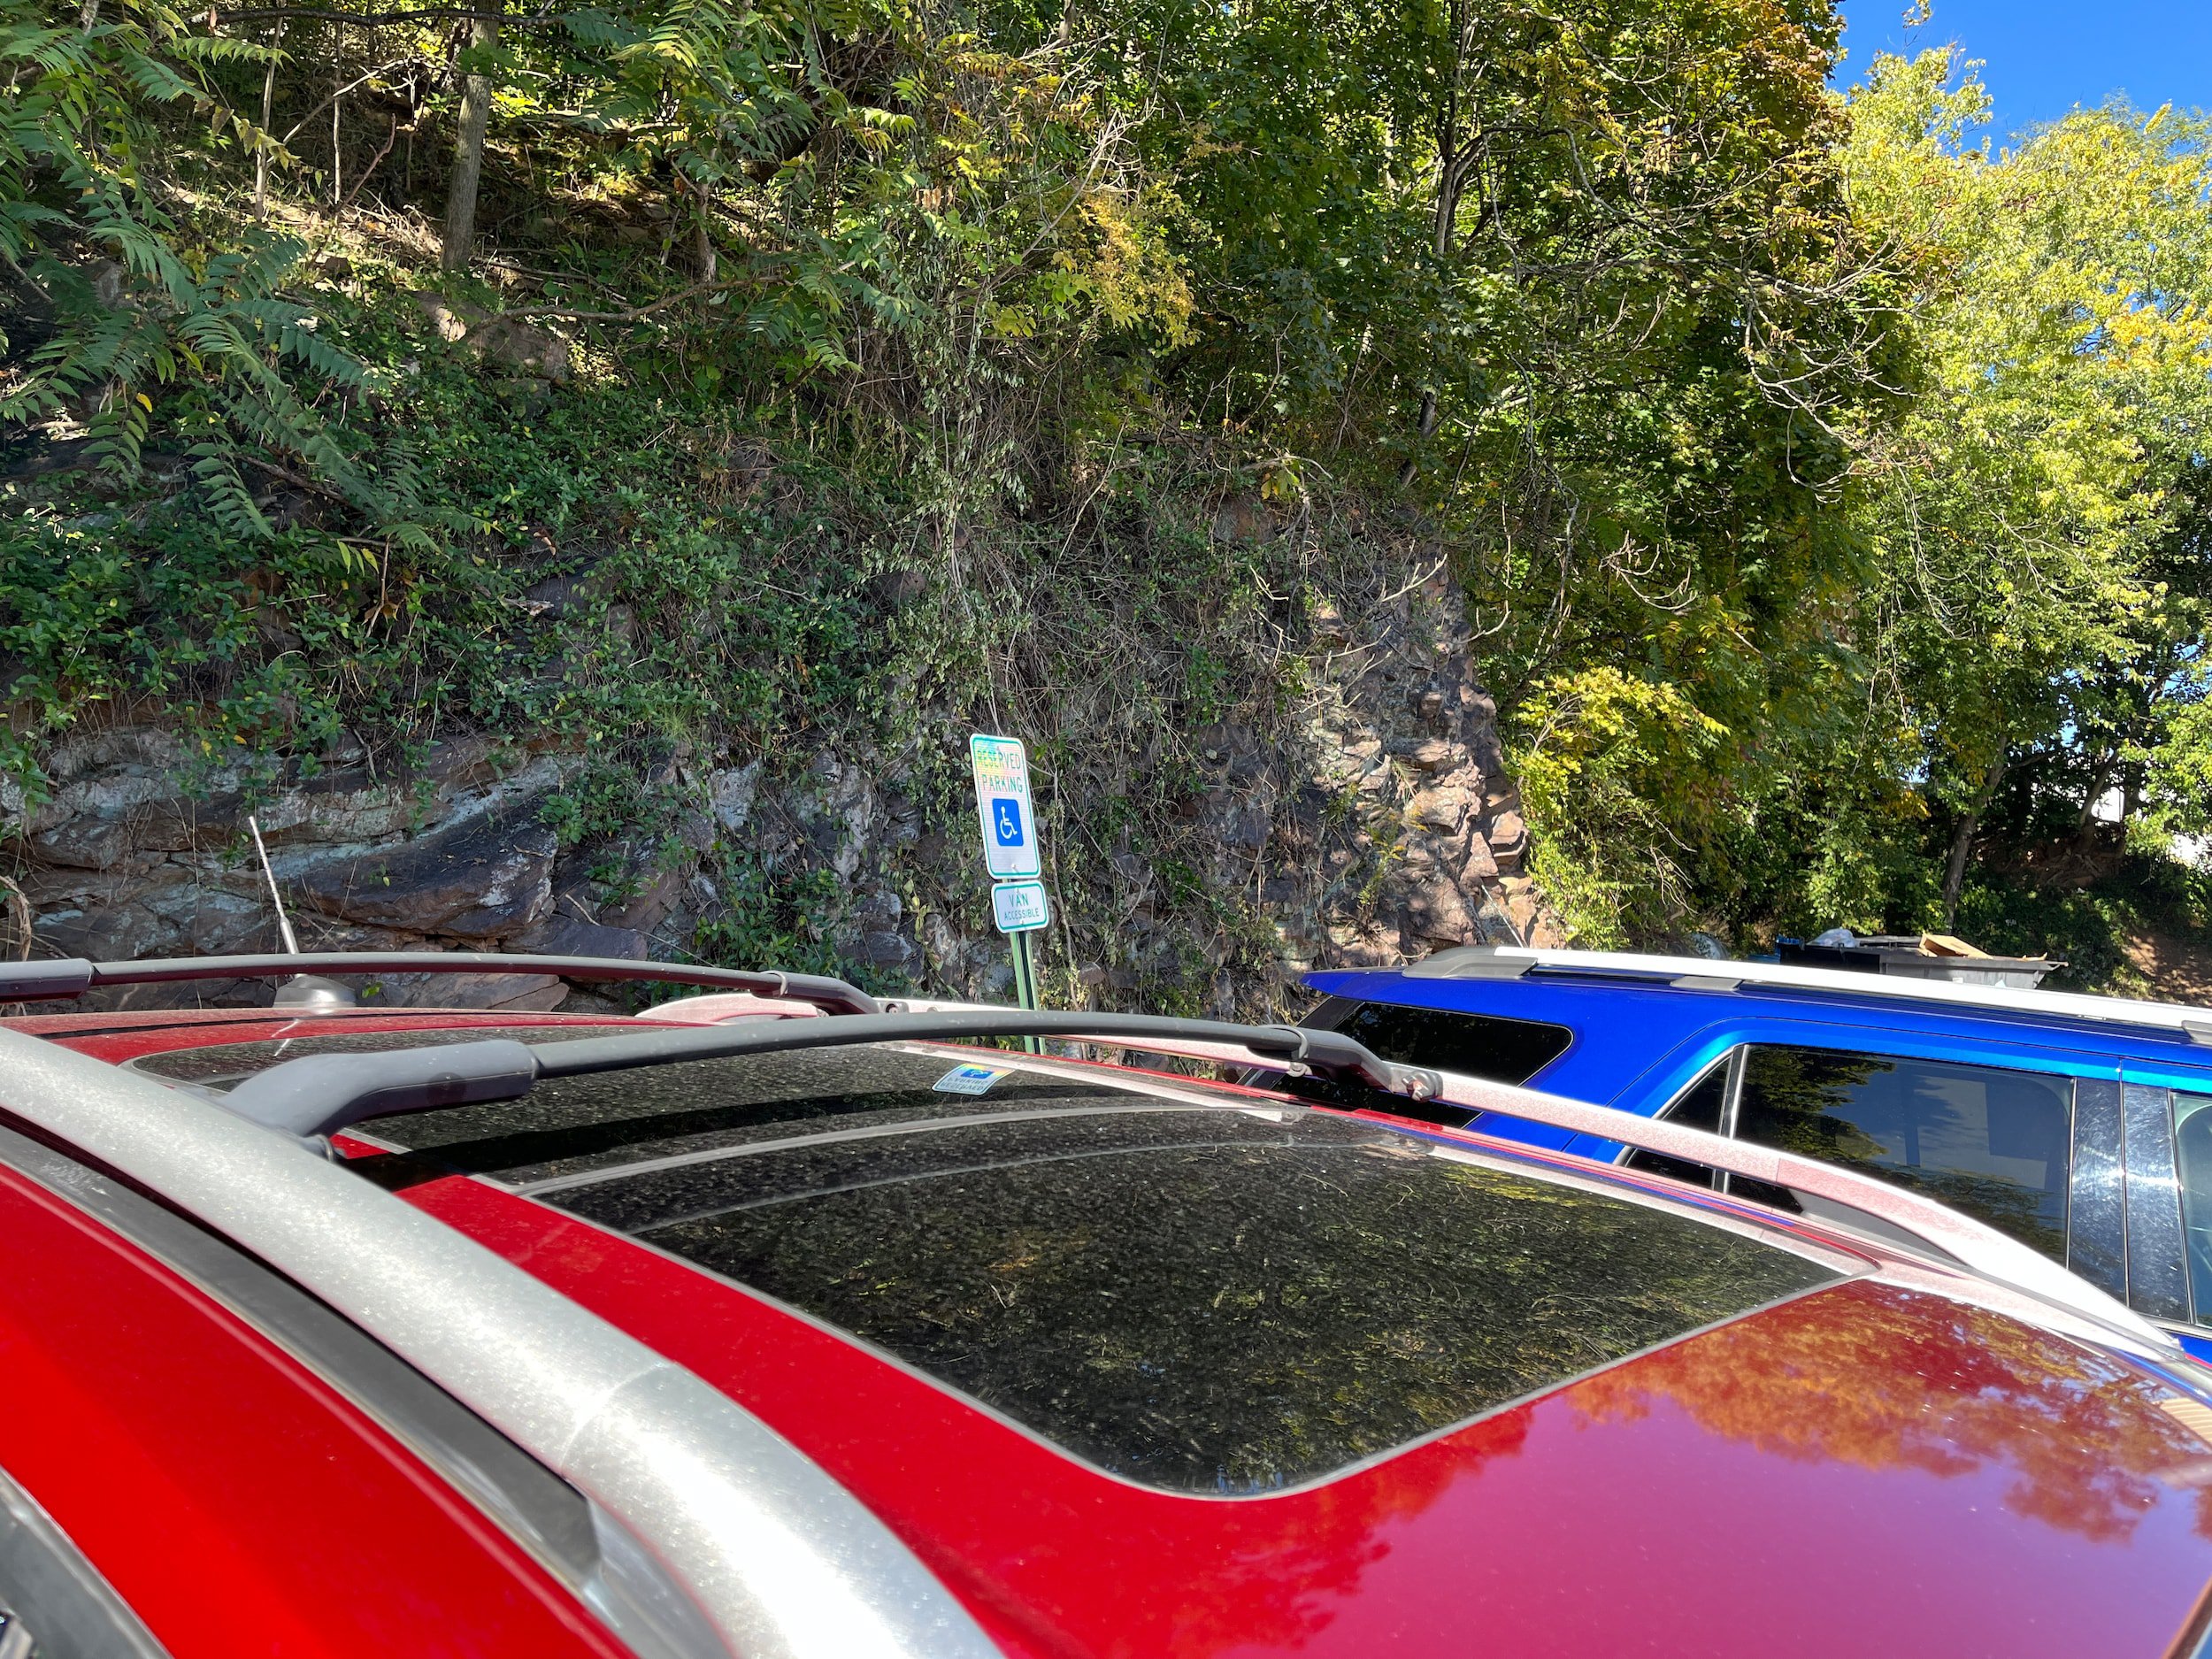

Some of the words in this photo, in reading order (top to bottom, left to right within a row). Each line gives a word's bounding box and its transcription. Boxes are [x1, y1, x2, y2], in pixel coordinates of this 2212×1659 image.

[978, 749, 1021, 769] RESERVED
[981, 773, 1024, 794] PARKING
[1008, 892, 1029, 907] VAN
[1003, 908, 1040, 921] ACCESSIBLE
